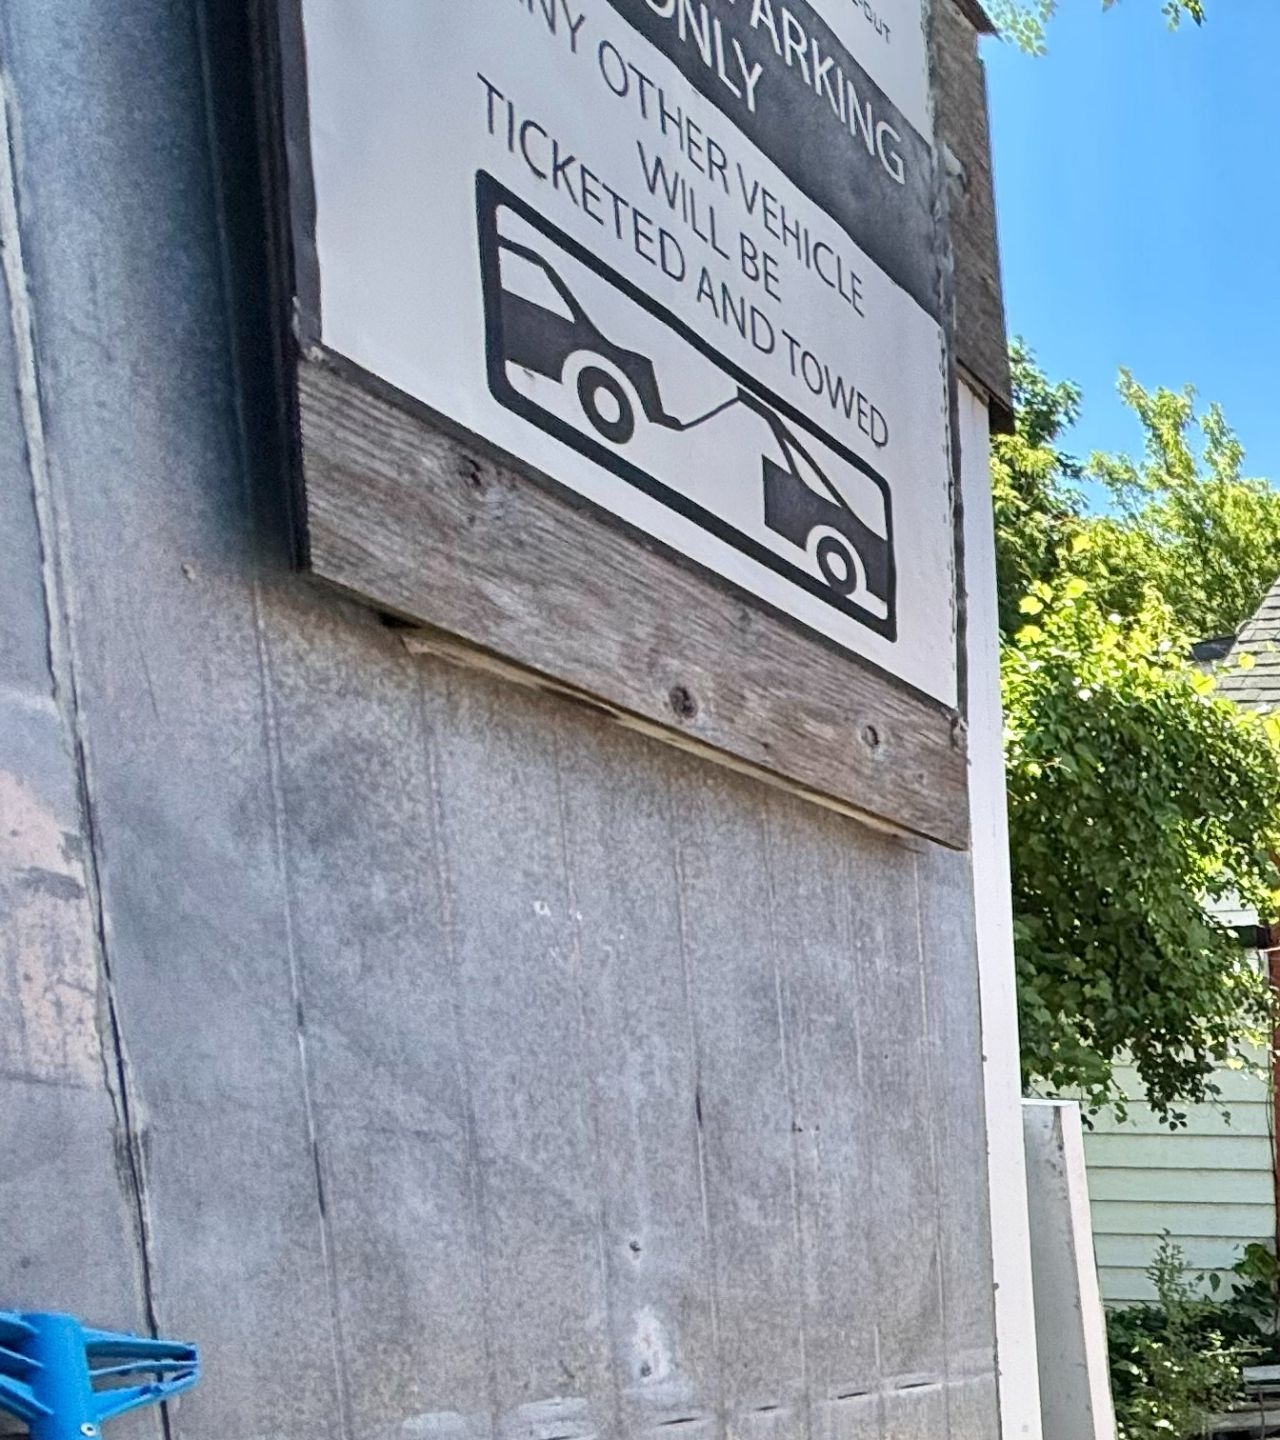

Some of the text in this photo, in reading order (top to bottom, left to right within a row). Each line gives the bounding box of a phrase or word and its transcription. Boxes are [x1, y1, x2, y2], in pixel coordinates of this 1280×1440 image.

[730, 0, 906, 186] ARKING
[851, 0, 891, 44] -OUT
[520, 0, 864, 319] NY OTHER VEHICLE
[637, 139, 781, 302] WILL BE
[476, 72, 889, 449] TICKETED AND TOWED
